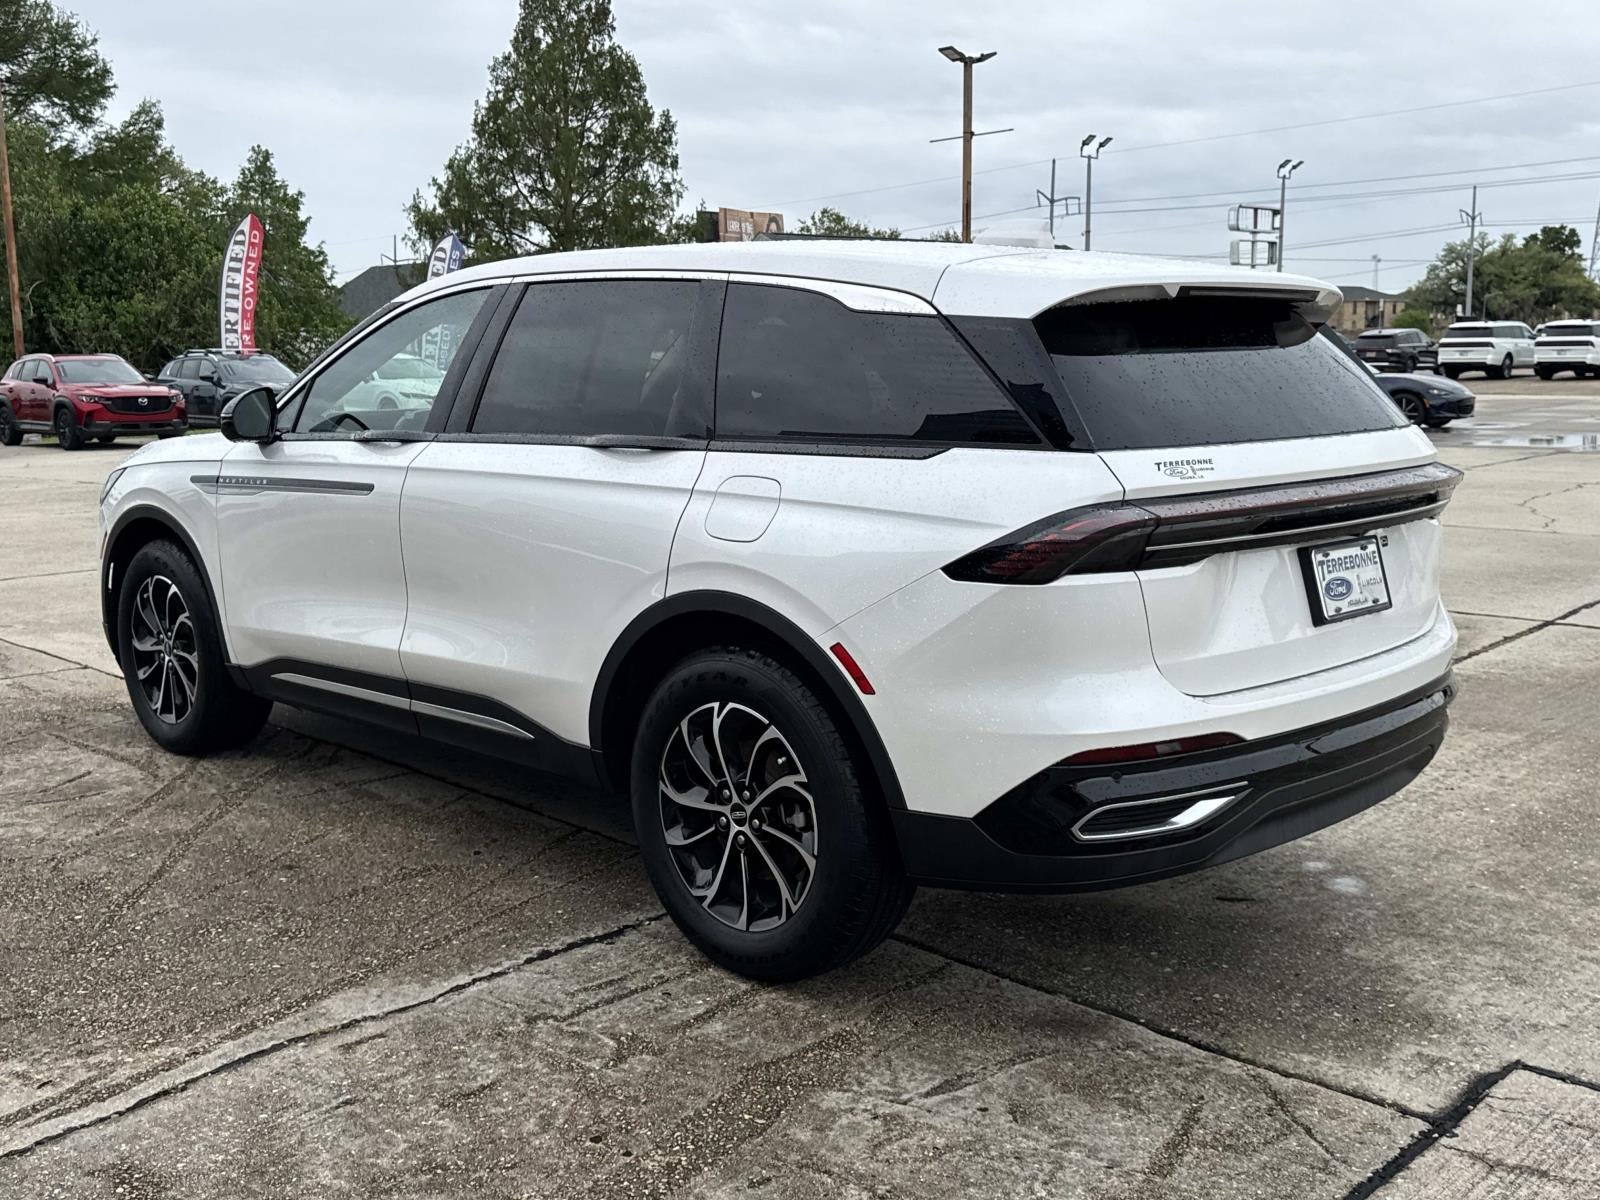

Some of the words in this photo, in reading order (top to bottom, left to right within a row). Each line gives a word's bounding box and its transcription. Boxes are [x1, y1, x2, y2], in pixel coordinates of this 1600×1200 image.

[224, 228, 247, 350] ERTIFIED
[1154, 458, 1214, 472] TERREBONNE
[1317, 550, 1379, 582] TERREBONNE
